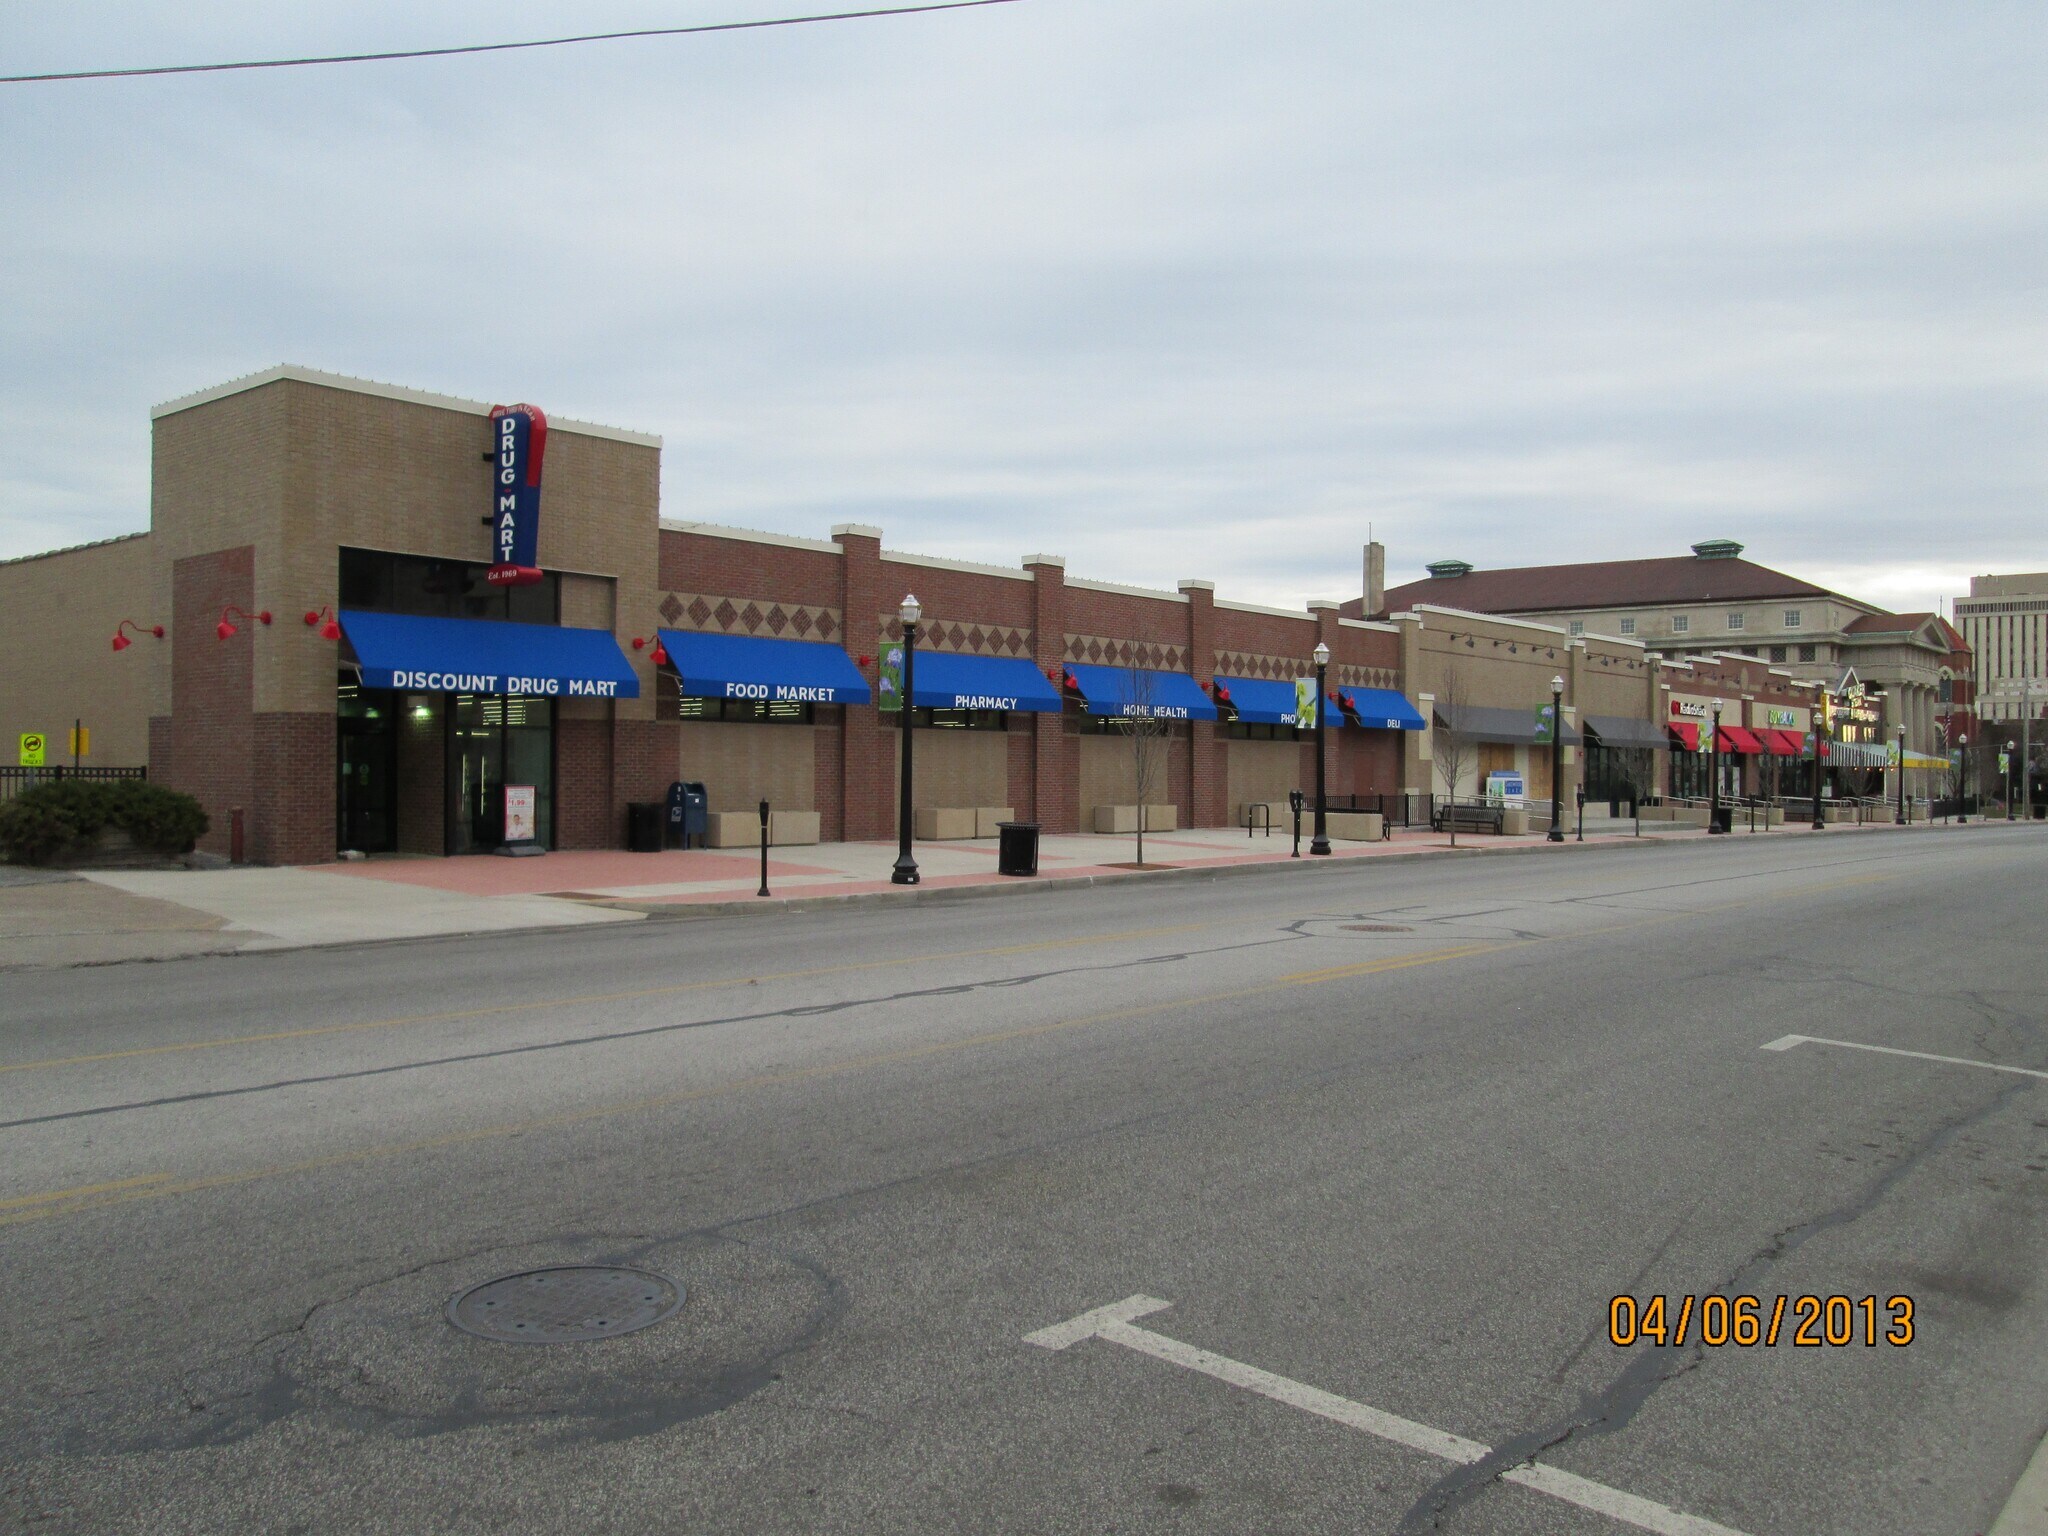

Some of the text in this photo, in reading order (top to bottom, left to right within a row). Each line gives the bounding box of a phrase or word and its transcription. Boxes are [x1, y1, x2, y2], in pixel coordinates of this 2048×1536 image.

[501, 418, 515, 484] DRUG
[500, 494, 516, 562] MART
[501, 569, 518, 578] 1969
[393, 670, 618, 696] DISCOUNT DRUG MART
[726, 682, 835, 702] FOOD MARKET
[955, 694, 1018, 710] PHARMACY
[1123, 704, 1188, 718] HOME HEALTH
[1280, 713, 1296, 725] PHO
[1387, 718, 1401, 729] DELI
